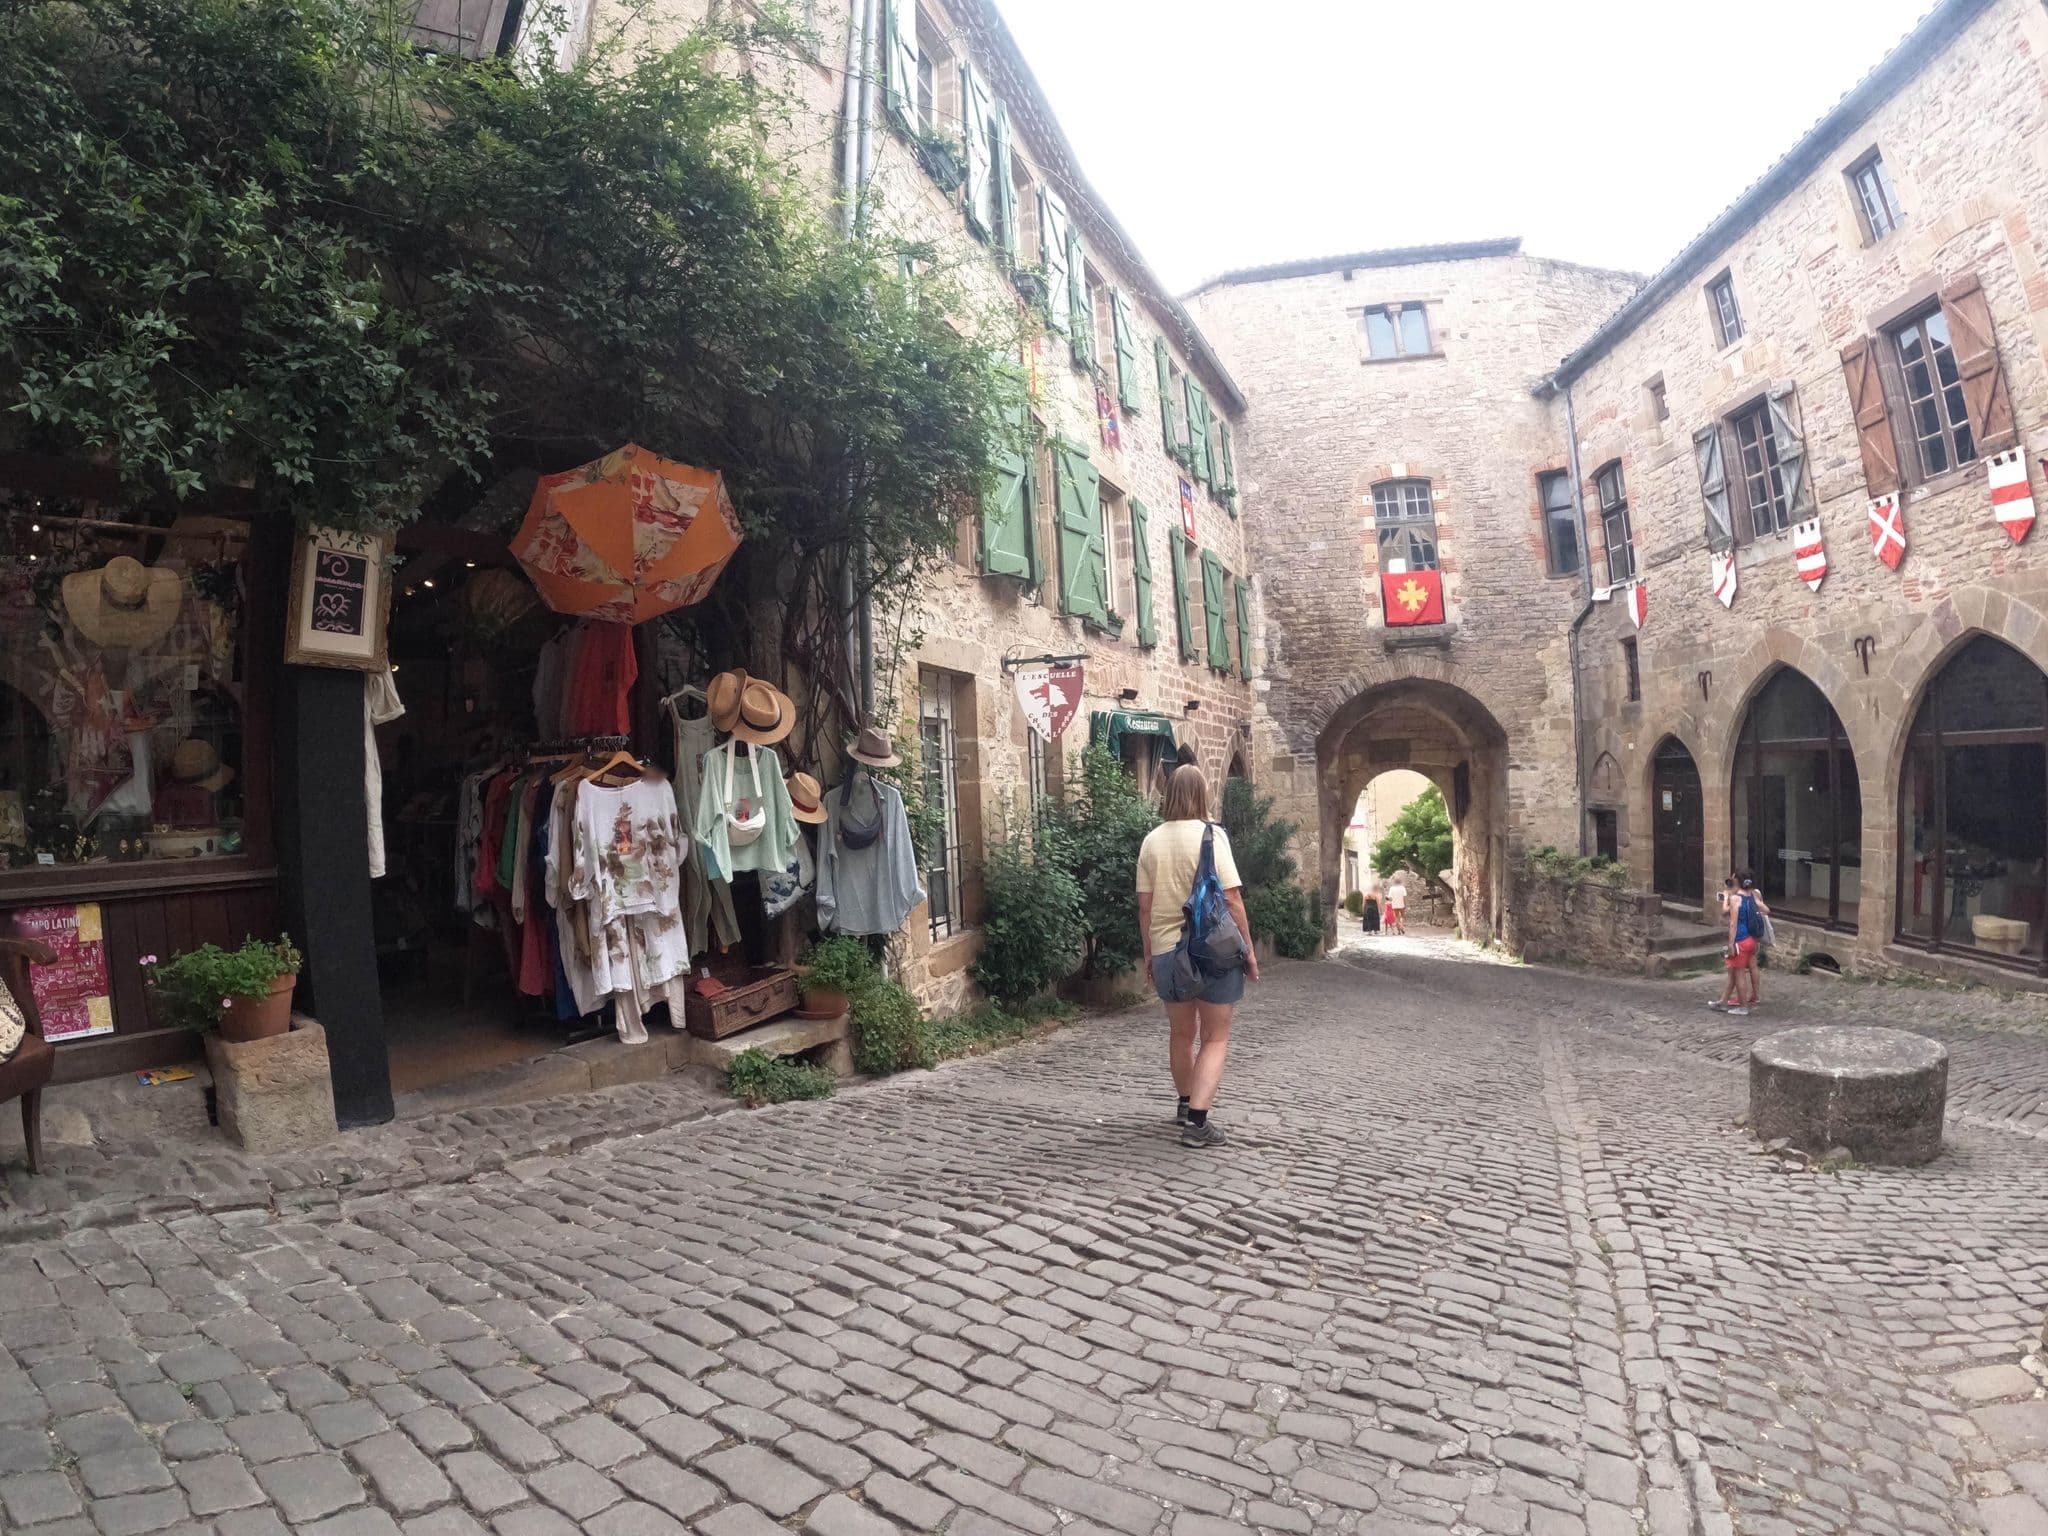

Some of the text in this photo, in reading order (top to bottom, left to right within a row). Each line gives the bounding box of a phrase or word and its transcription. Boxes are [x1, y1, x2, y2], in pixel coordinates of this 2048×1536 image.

[1022, 671, 1077, 680] L'ESCUELLE
[1028, 710, 1073, 737] CHEVALIERS
[51, 915, 81, 930] LATINO
